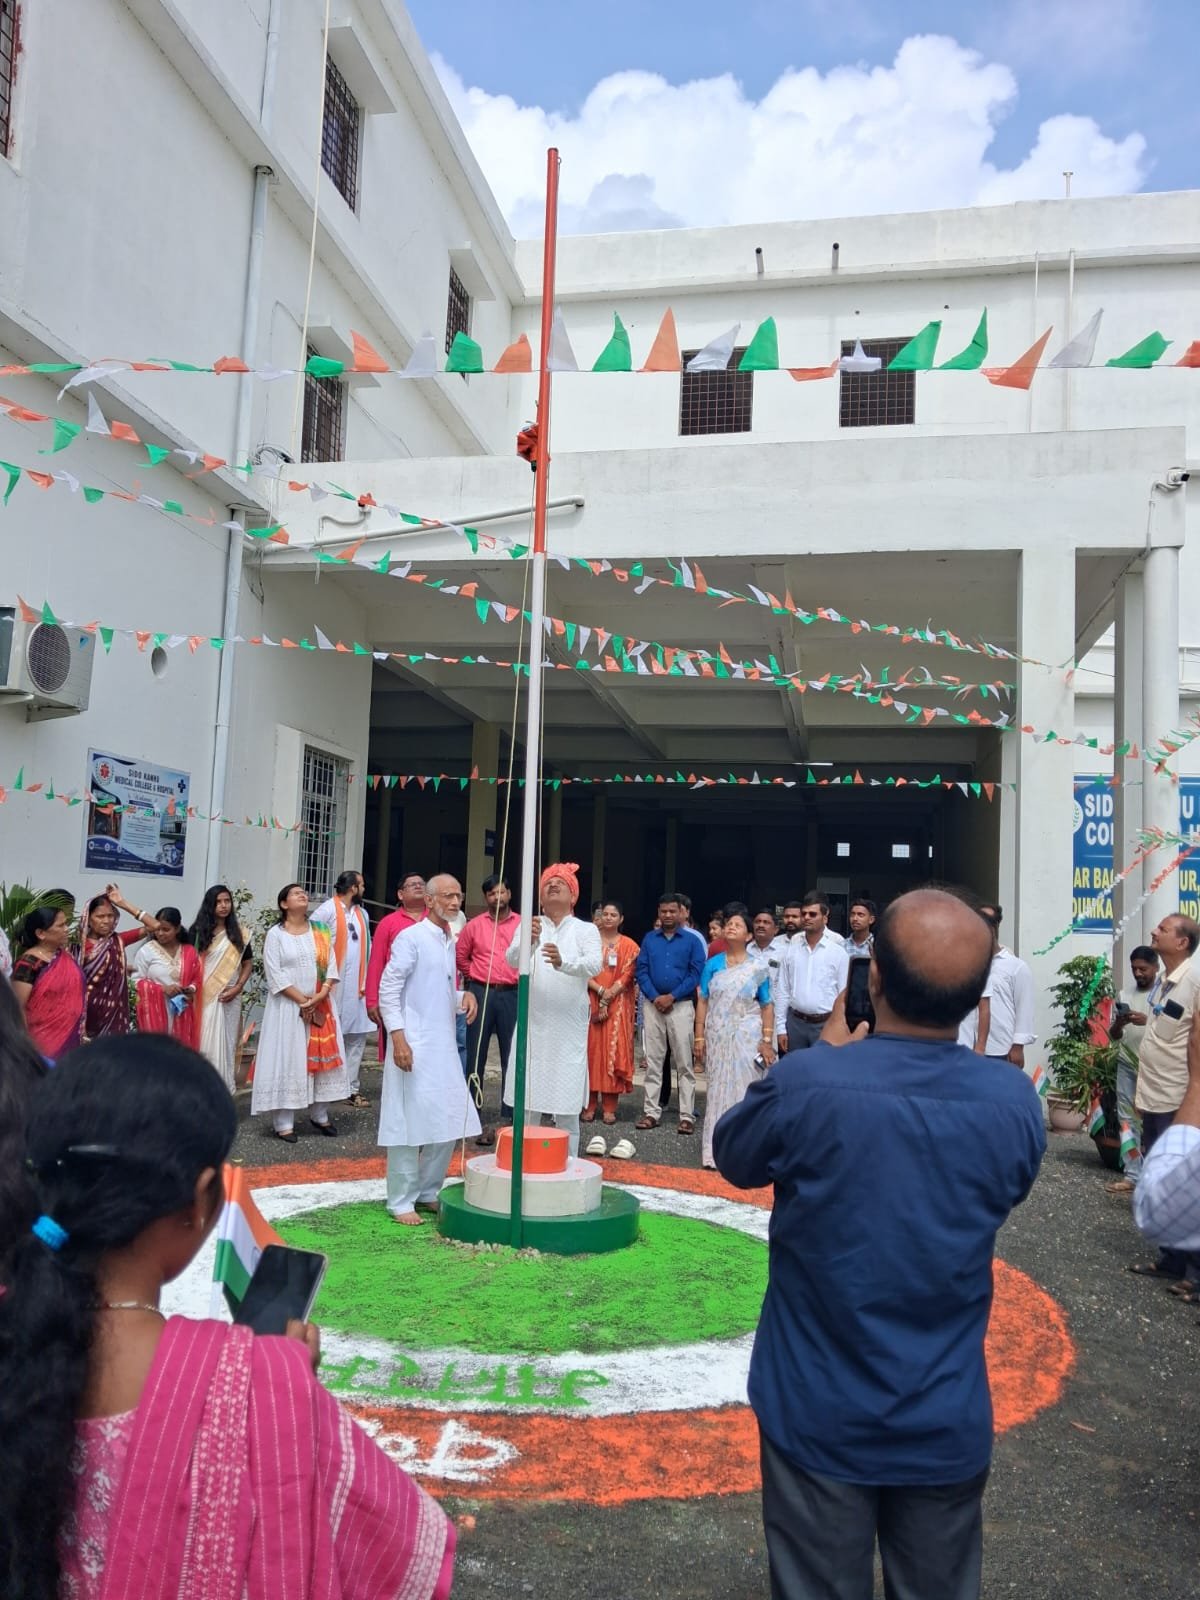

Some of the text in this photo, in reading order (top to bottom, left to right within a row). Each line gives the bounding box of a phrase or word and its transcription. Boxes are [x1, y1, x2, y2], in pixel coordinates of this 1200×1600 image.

[1085, 793, 1194, 818] SID U
[1074, 867, 1090, 888] AR
